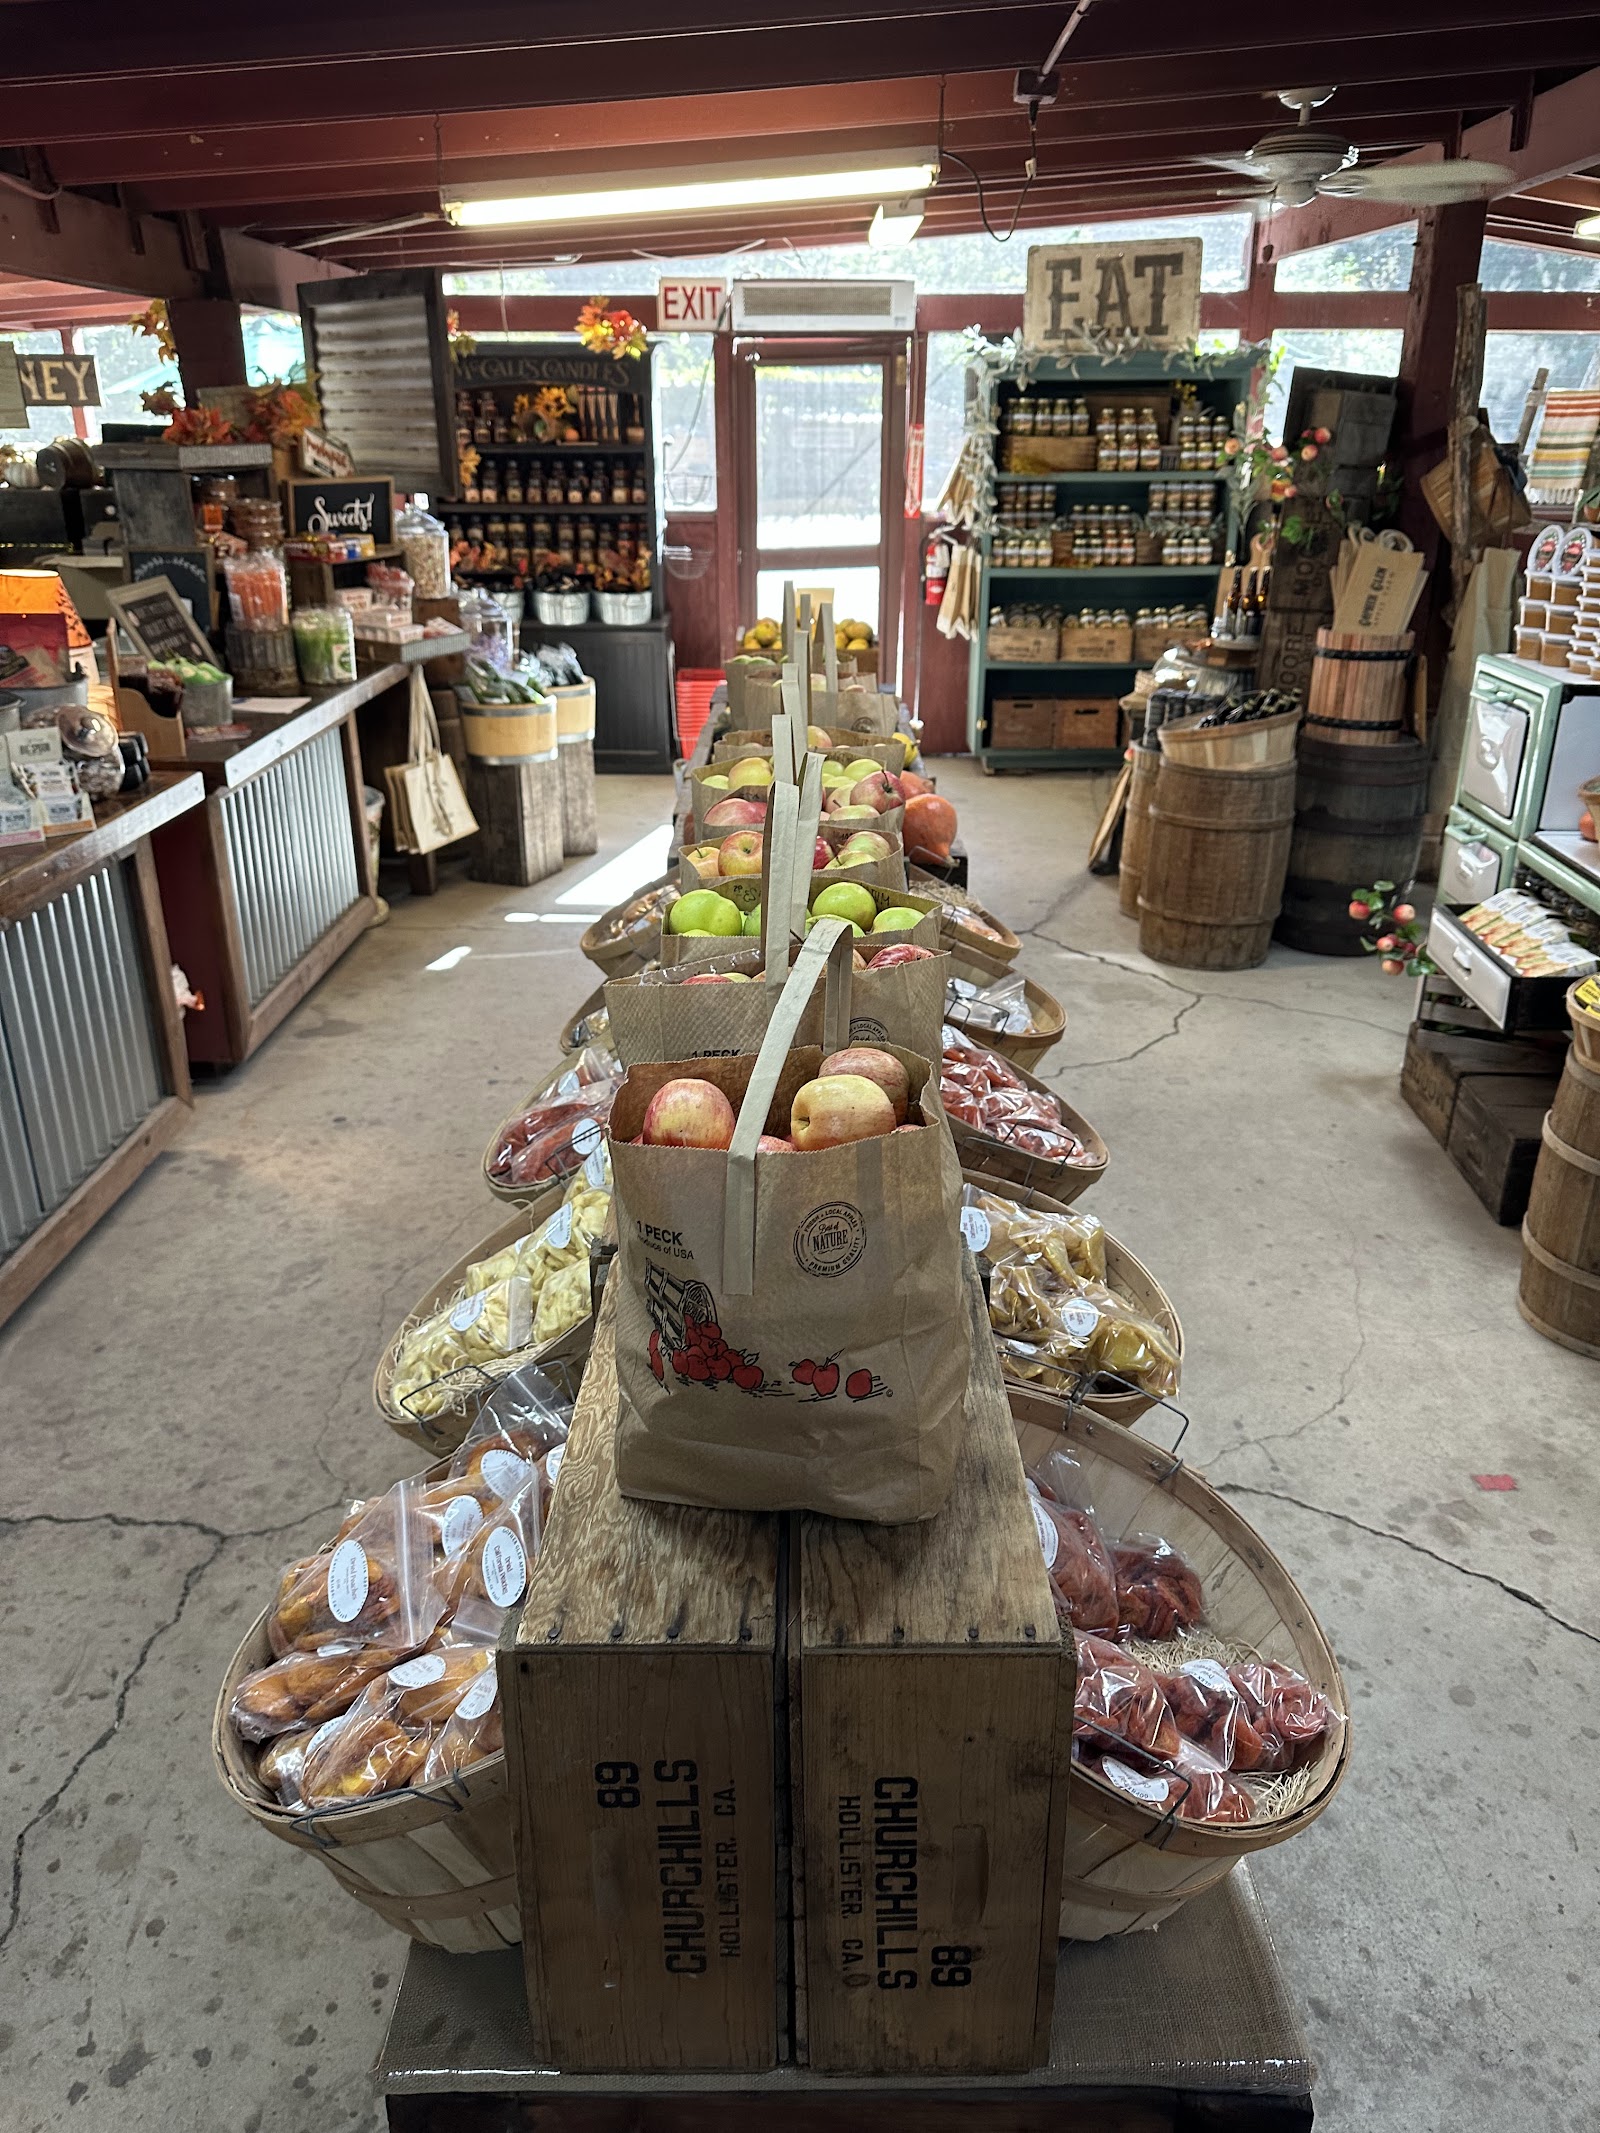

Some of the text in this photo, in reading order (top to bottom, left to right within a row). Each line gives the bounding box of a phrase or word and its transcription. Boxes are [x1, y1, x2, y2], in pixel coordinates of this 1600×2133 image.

[664, 286, 721, 320] EXIT
[1044, 252, 1184, 340] EAT
[541, 357, 630, 387] CANDLES
[307, 492, 375, 533] Sweets!
[825, 1208, 842, 1216] LOCAL
[636, 1220, 683, 1247] 1 PECK
[812, 1229, 849, 1251] NATURE
[663, 1246, 671, 1256] of
[673, 1247, 695, 1260] USA
[808, 1237, 861, 1273] PREMIUM QUALITY
[493, 1544, 509, 1596] California Peaches
[504, 1556, 514, 1573] Dried
[515, 1544, 523, 1560] GLEN
[350, 1557, 359, 1601] Dried Peaches
[595, 1760, 641, 1810] 89
[713, 1778, 737, 1817] CA.
[653, 1758, 708, 1975] CHURCHILLS
[873, 1775, 919, 1990] CHURCHILLS
[841, 1938, 864, 1972] CA.
[930, 1944, 972, 1988] 89
